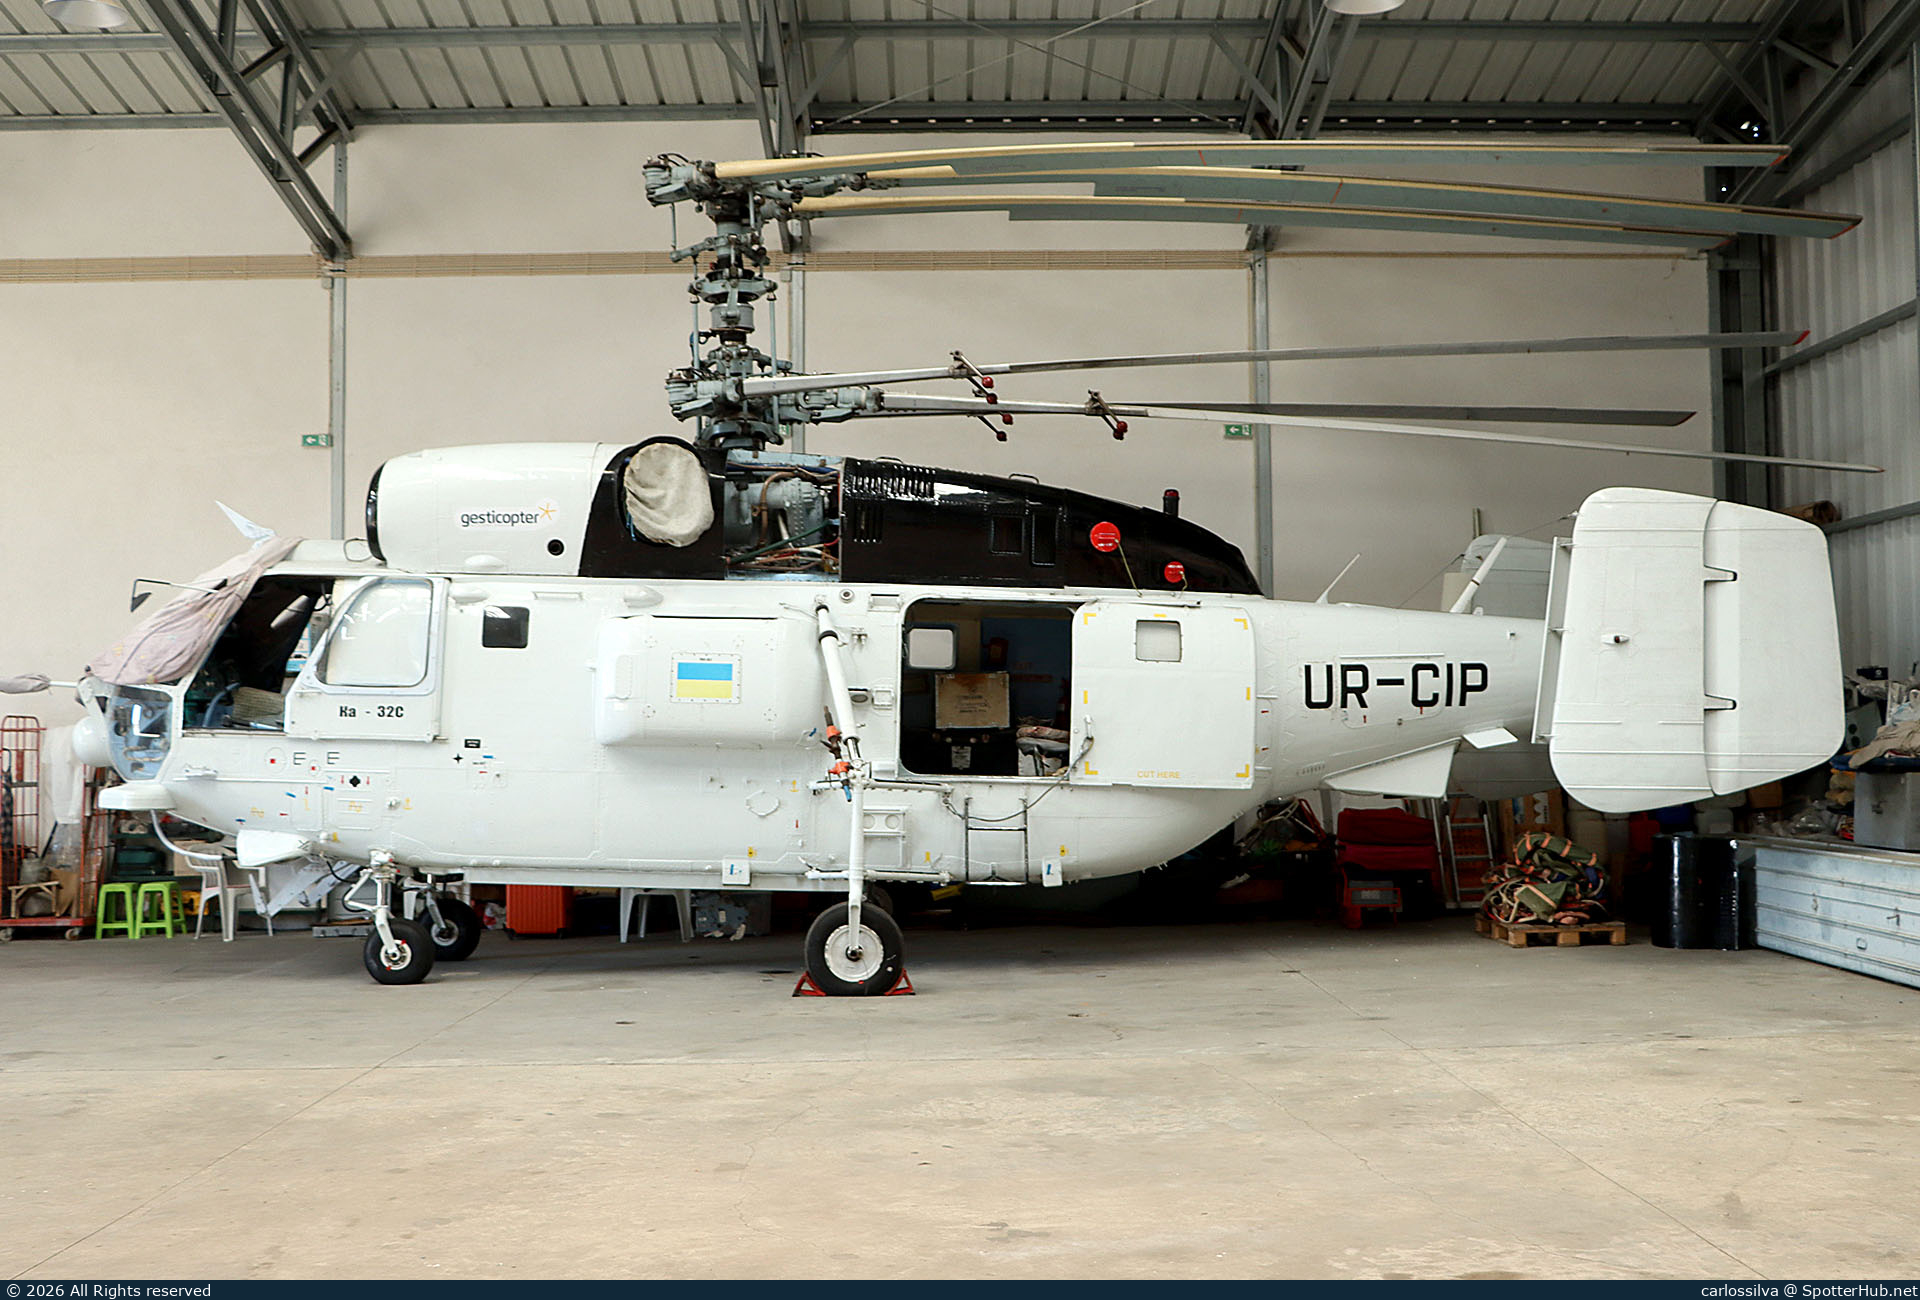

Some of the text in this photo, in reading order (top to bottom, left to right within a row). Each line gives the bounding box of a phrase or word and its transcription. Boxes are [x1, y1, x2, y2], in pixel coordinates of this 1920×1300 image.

[460, 510, 540, 527] gesticopter
[1304, 662, 1489, 709] UR-CIP
[377, 705, 405, 718] 32C
[1136, 770, 1182, 779] CUT HERE
